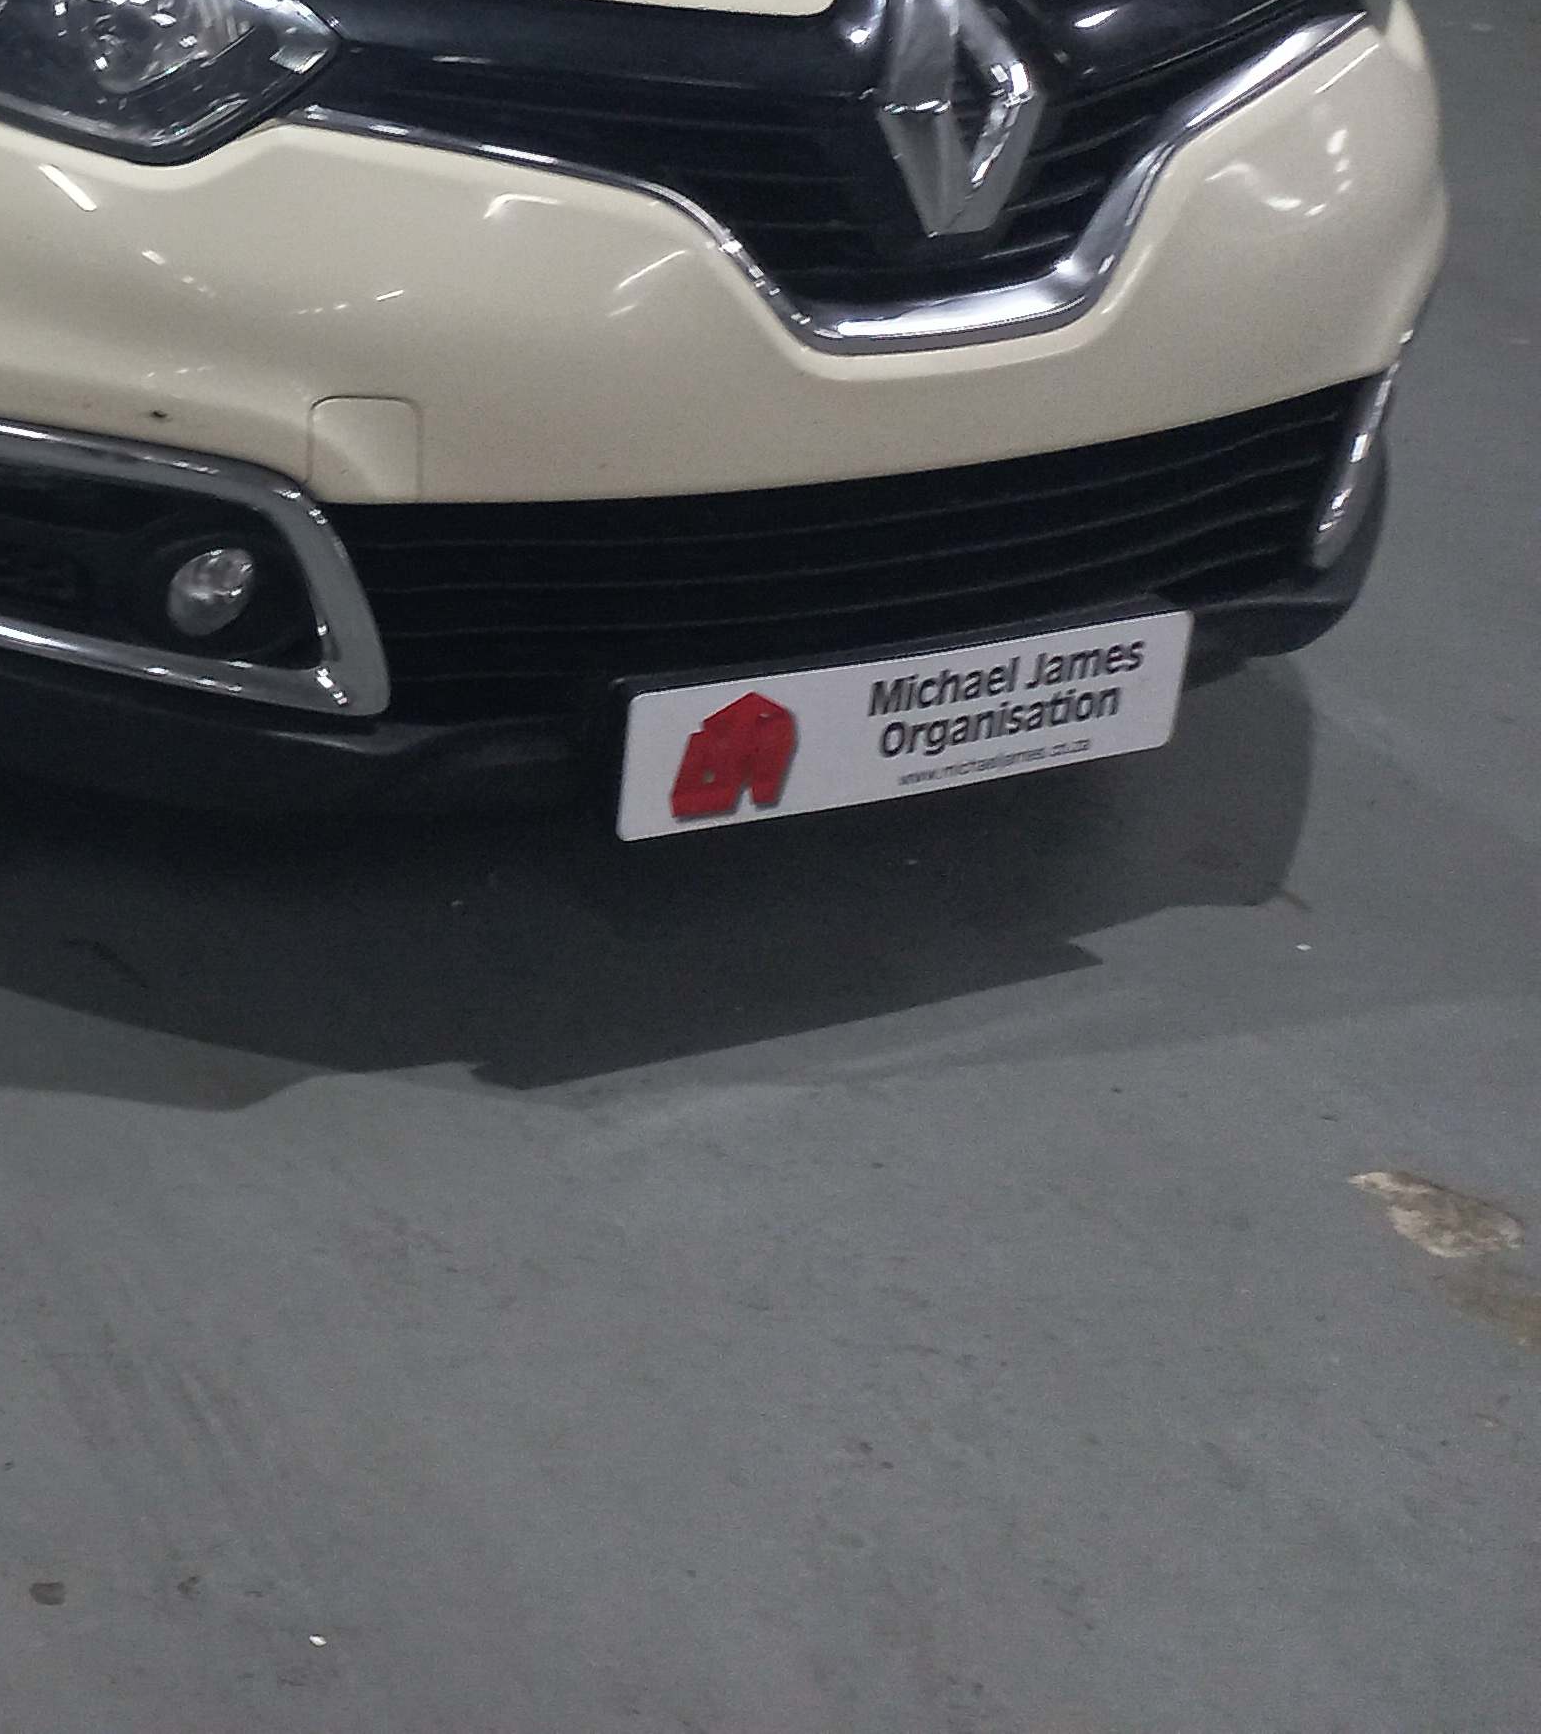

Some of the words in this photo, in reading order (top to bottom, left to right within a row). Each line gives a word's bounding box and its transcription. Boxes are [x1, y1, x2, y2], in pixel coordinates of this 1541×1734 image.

[869, 655, 1021, 716] Michael
[1025, 640, 1146, 691] James
[880, 687, 1122, 759] Organisation
